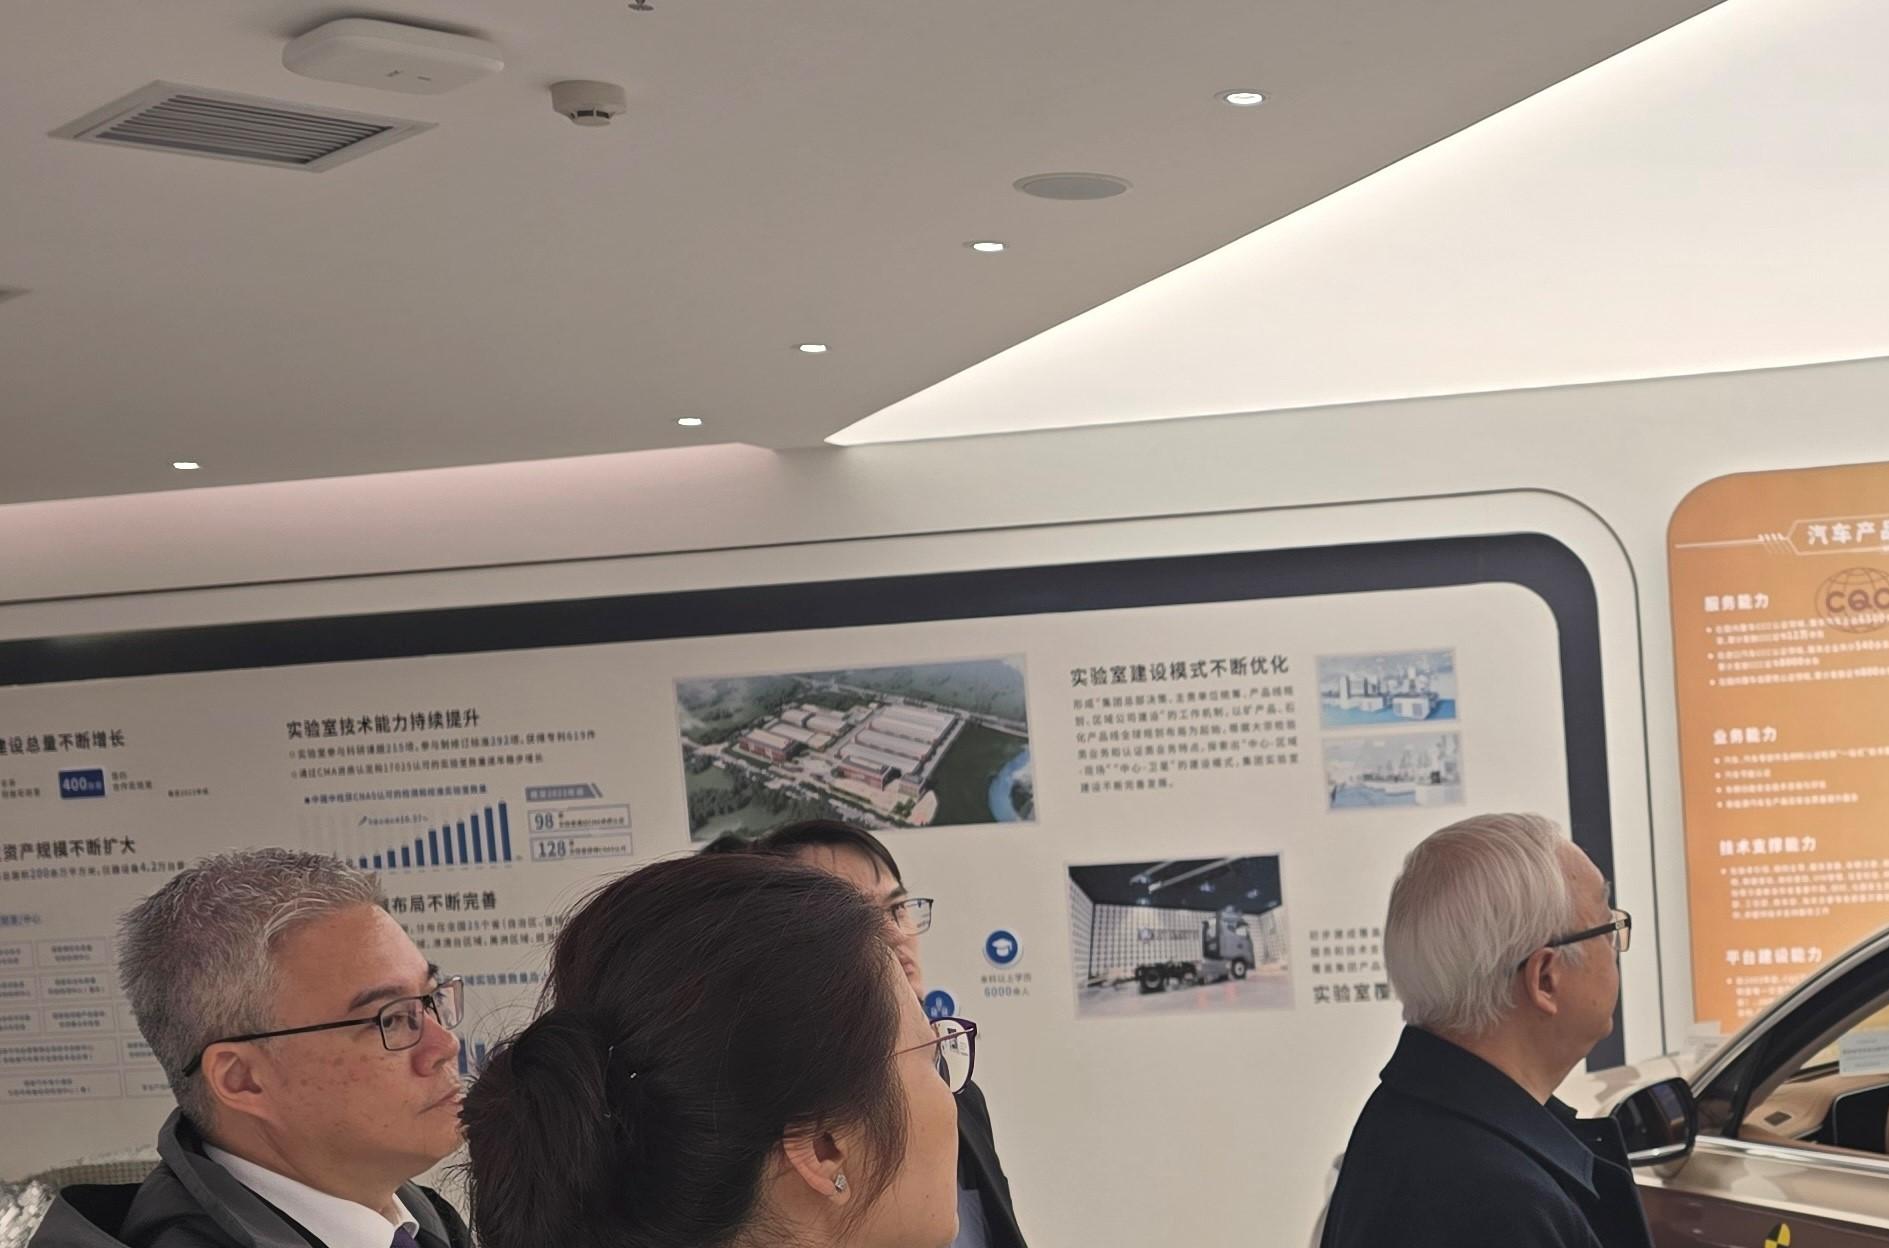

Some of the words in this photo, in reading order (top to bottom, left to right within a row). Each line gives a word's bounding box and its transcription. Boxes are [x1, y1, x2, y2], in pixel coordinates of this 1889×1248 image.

[1704, 593, 1768, 612] 服务能力
[1070, 655, 1289, 687] 实验室建设模式不断优化
[286, 708, 480, 740] 实验室技术能力持续提升
[1713, 726, 1777, 745] 业务能力
[534, 811, 554, 831] 98
[0, 835, 136, 864] 资产规模不断扩大
[539, 840, 566, 858] 128
[1726, 946, 1822, 966] 平台建设能力
